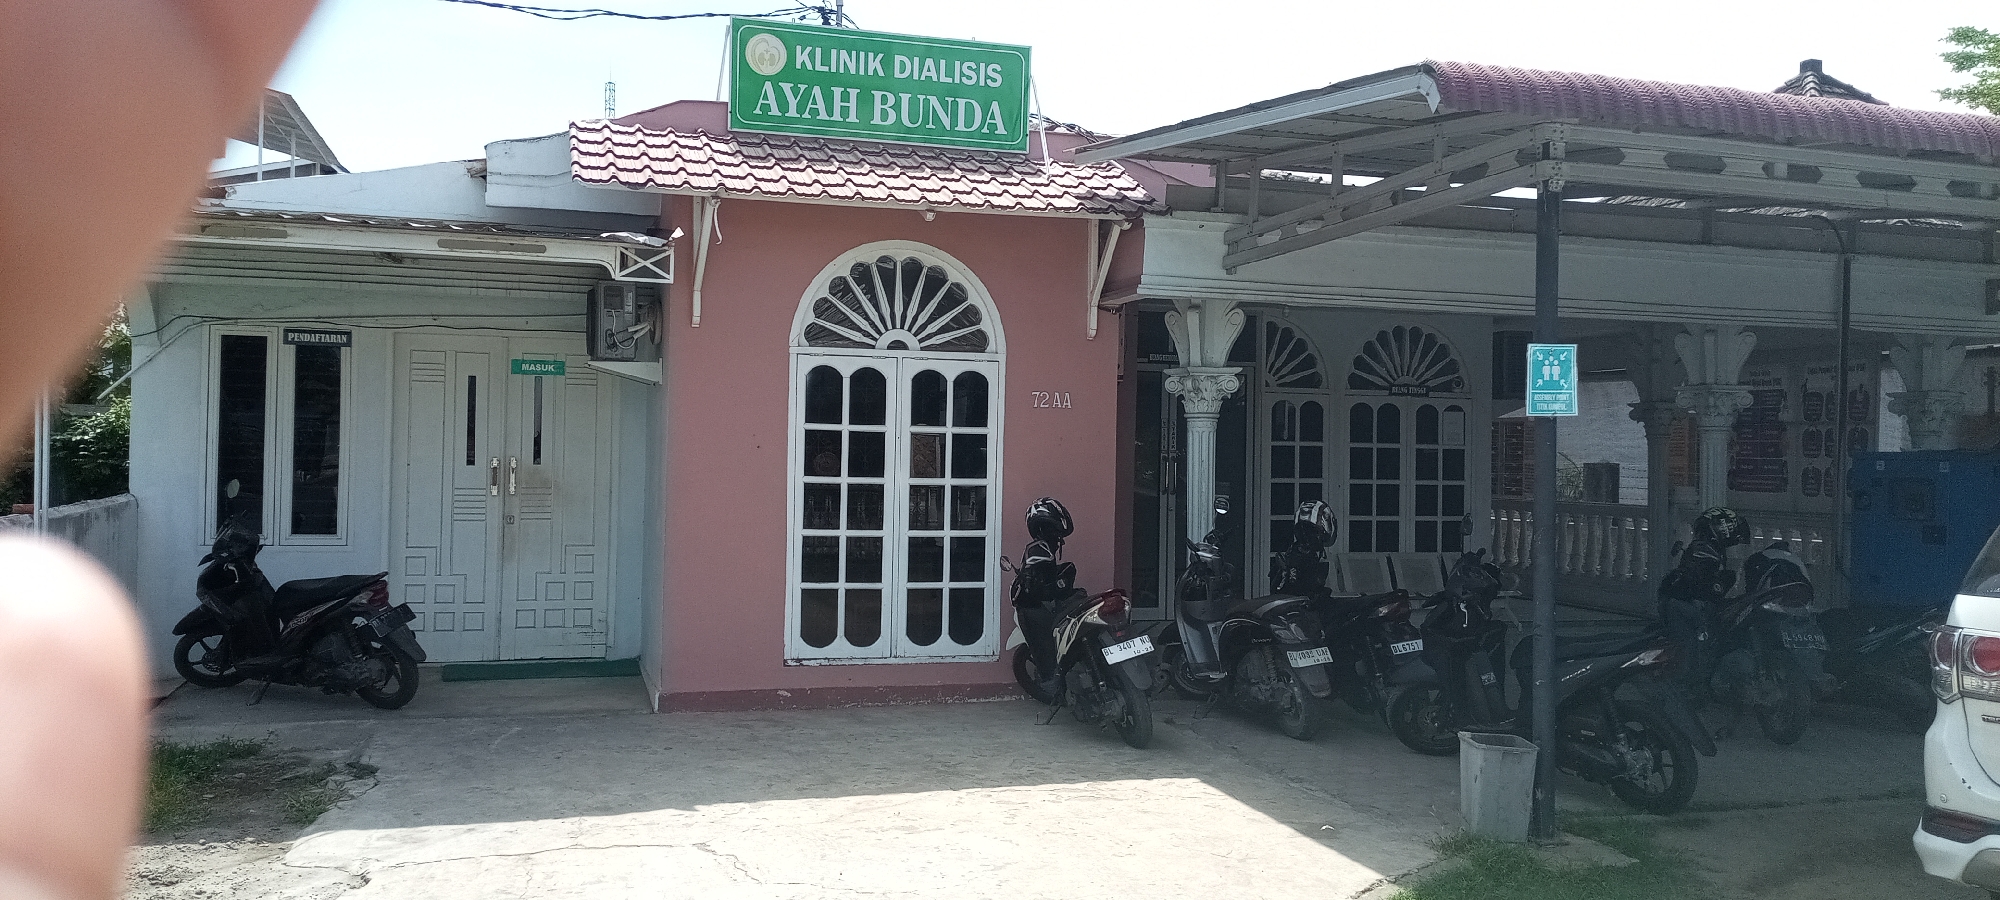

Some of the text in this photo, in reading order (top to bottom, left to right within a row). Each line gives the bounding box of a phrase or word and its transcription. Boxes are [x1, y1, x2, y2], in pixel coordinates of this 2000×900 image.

[795, 45, 1002, 88] KLINIK DIALISIS
[753, 80, 1008, 135] AYAH BUNDA
[287, 332, 347, 343] PENDAFTARAN
[521, 363, 555, 372] MASUK
[1103, 647, 1114, 657] BL
[1116, 639, 1136, 652] 3407
